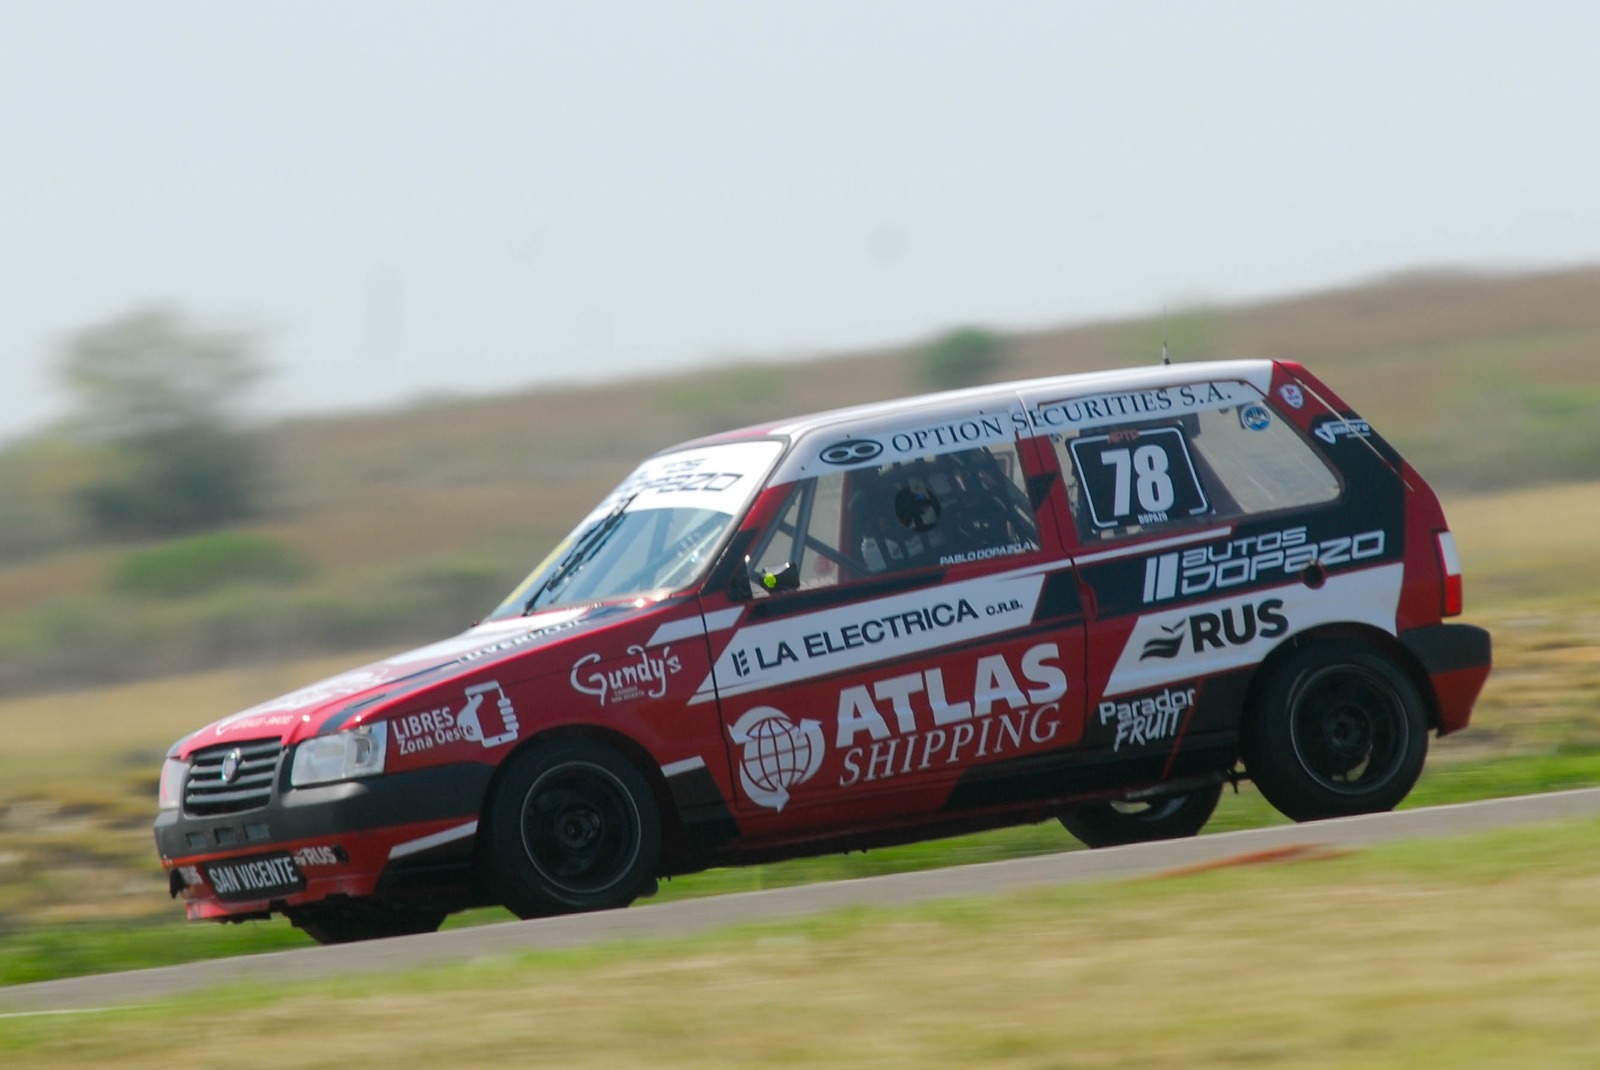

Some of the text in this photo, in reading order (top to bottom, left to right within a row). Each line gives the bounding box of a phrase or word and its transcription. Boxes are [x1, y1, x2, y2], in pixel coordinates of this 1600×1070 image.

[892, 381, 1232, 453] OPTION SECURITIES S.A.
[1100, 444, 1175, 517] 78
[1137, 511, 1169, 525] DOPAZO
[940, 551, 976, 566] PABLO
[977, 543, 1022, 561] DOPAZO
[1181, 530, 1385, 595] DOPAZO
[1182, 526, 1307, 568] AUTOS
[755, 640, 799, 671] LA
[802, 598, 979, 659] ELECTRICA
[1189, 598, 1289, 654] RUS
[570, 645, 682, 707] Gundy's
[835, 643, 1068, 748] ATLAS
[392, 706, 455, 745] LIBRES
[1098, 688, 1196, 726] Parador
[399, 724, 474, 755] Zona Oeste
[838, 702, 1061, 788] SHIPPING
[208, 865, 241, 894] SAN
[236, 856, 299, 891] VICENTE
[305, 846, 337, 866] RUS
